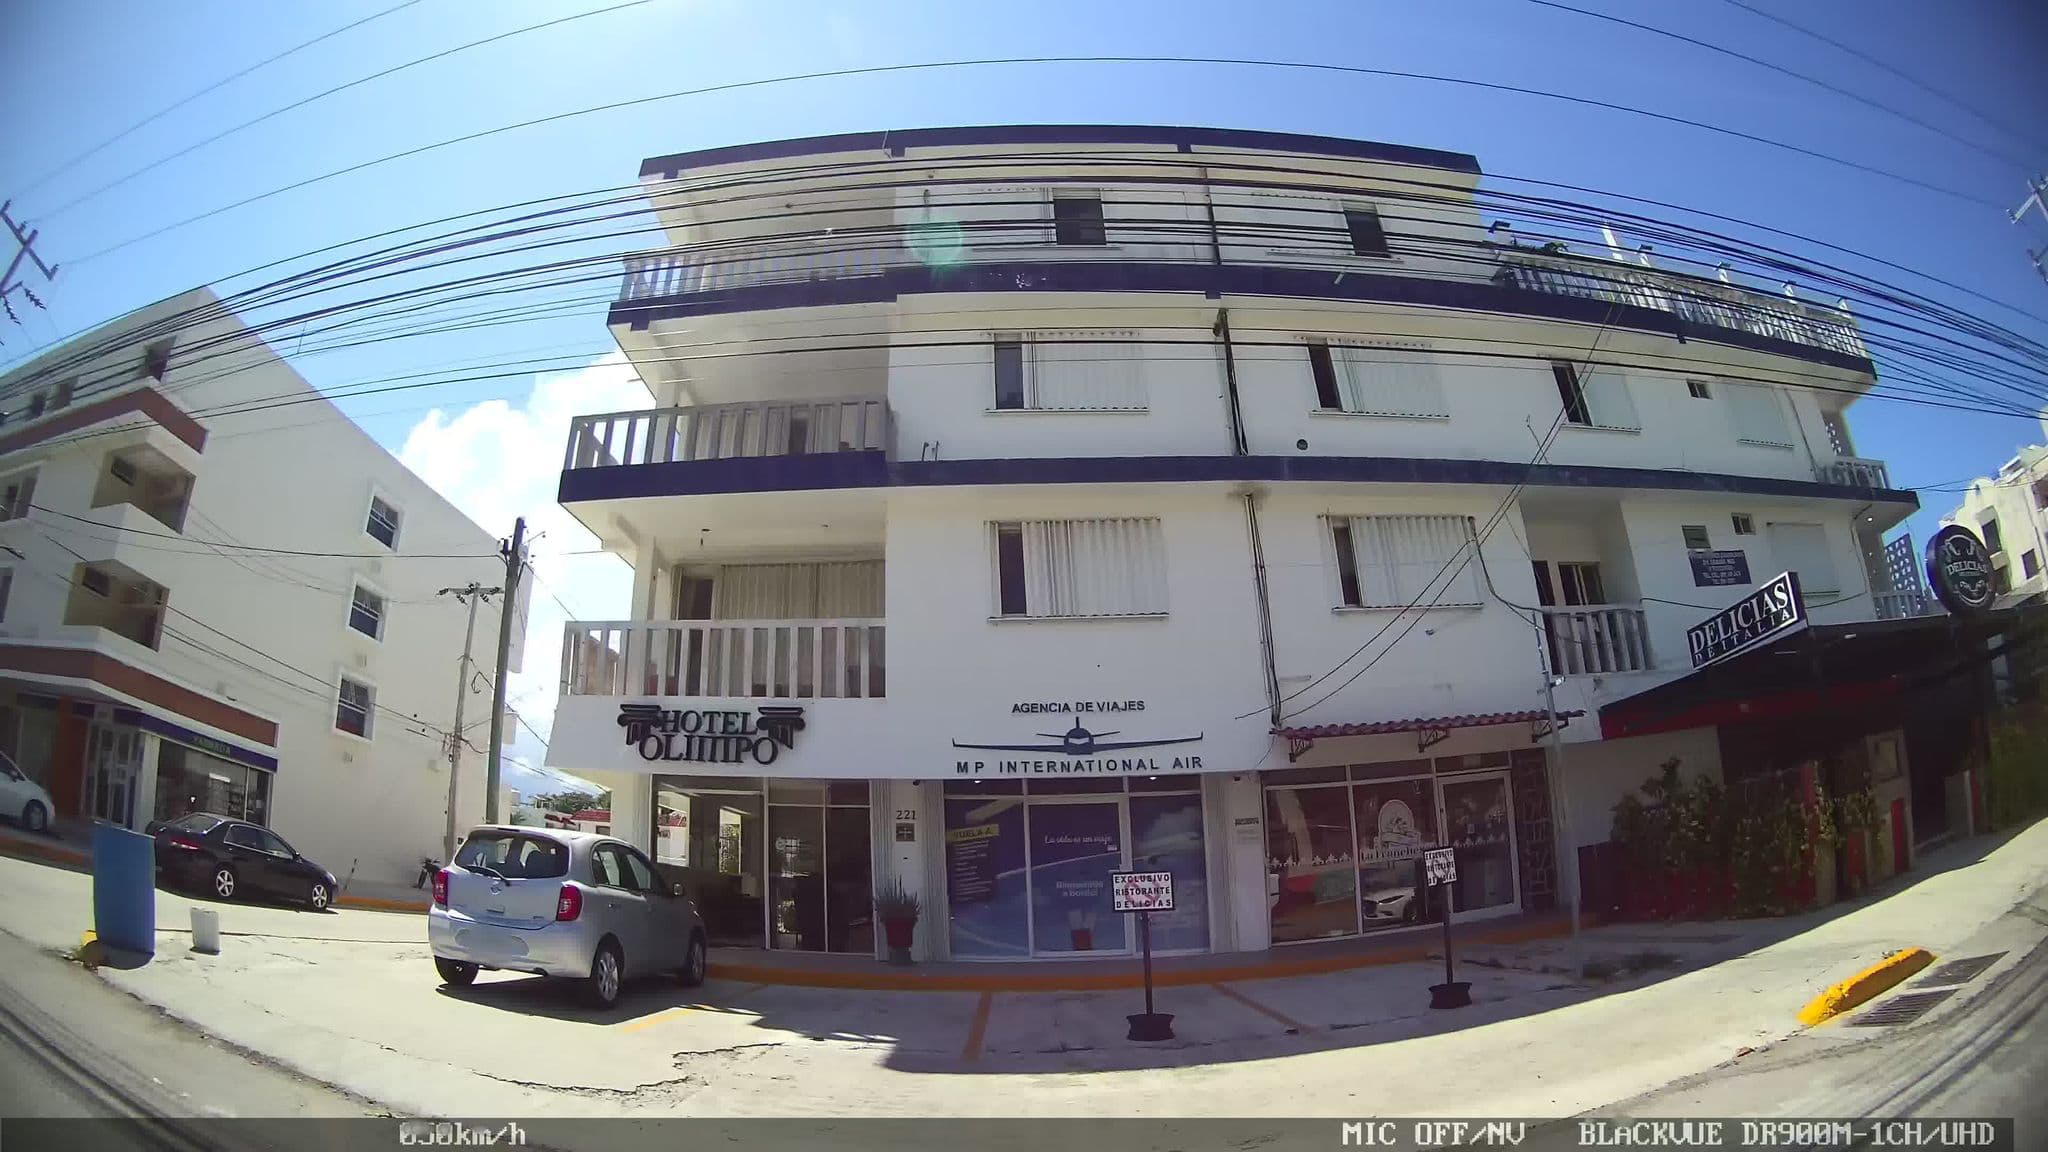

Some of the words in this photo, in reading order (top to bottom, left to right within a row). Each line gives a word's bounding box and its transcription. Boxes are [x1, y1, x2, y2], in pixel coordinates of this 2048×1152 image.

[1690, 582, 1789, 654] DELICIAS
[1694, 647, 1716, 665] DE
[1721, 609, 1791, 651] ITALIA
[1011, 702, 1072, 713] AGENCIA
[1075, 701, 1094, 712] DE
[1097, 700, 1146, 712] VIAJES
[659, 709, 759, 735] HOTEL
[956, 760, 985, 773] MP
[999, 758, 1160, 773] INTERNATIONAL
[1172, 756, 1203, 769] AIR
[895, 809, 917, 820] 221
[1114, 873, 1170, 883] EXCLUSIVO
[1115, 886, 1171, 896] RISTORANTE
[1116, 899, 1172, 909] DELICIAS
